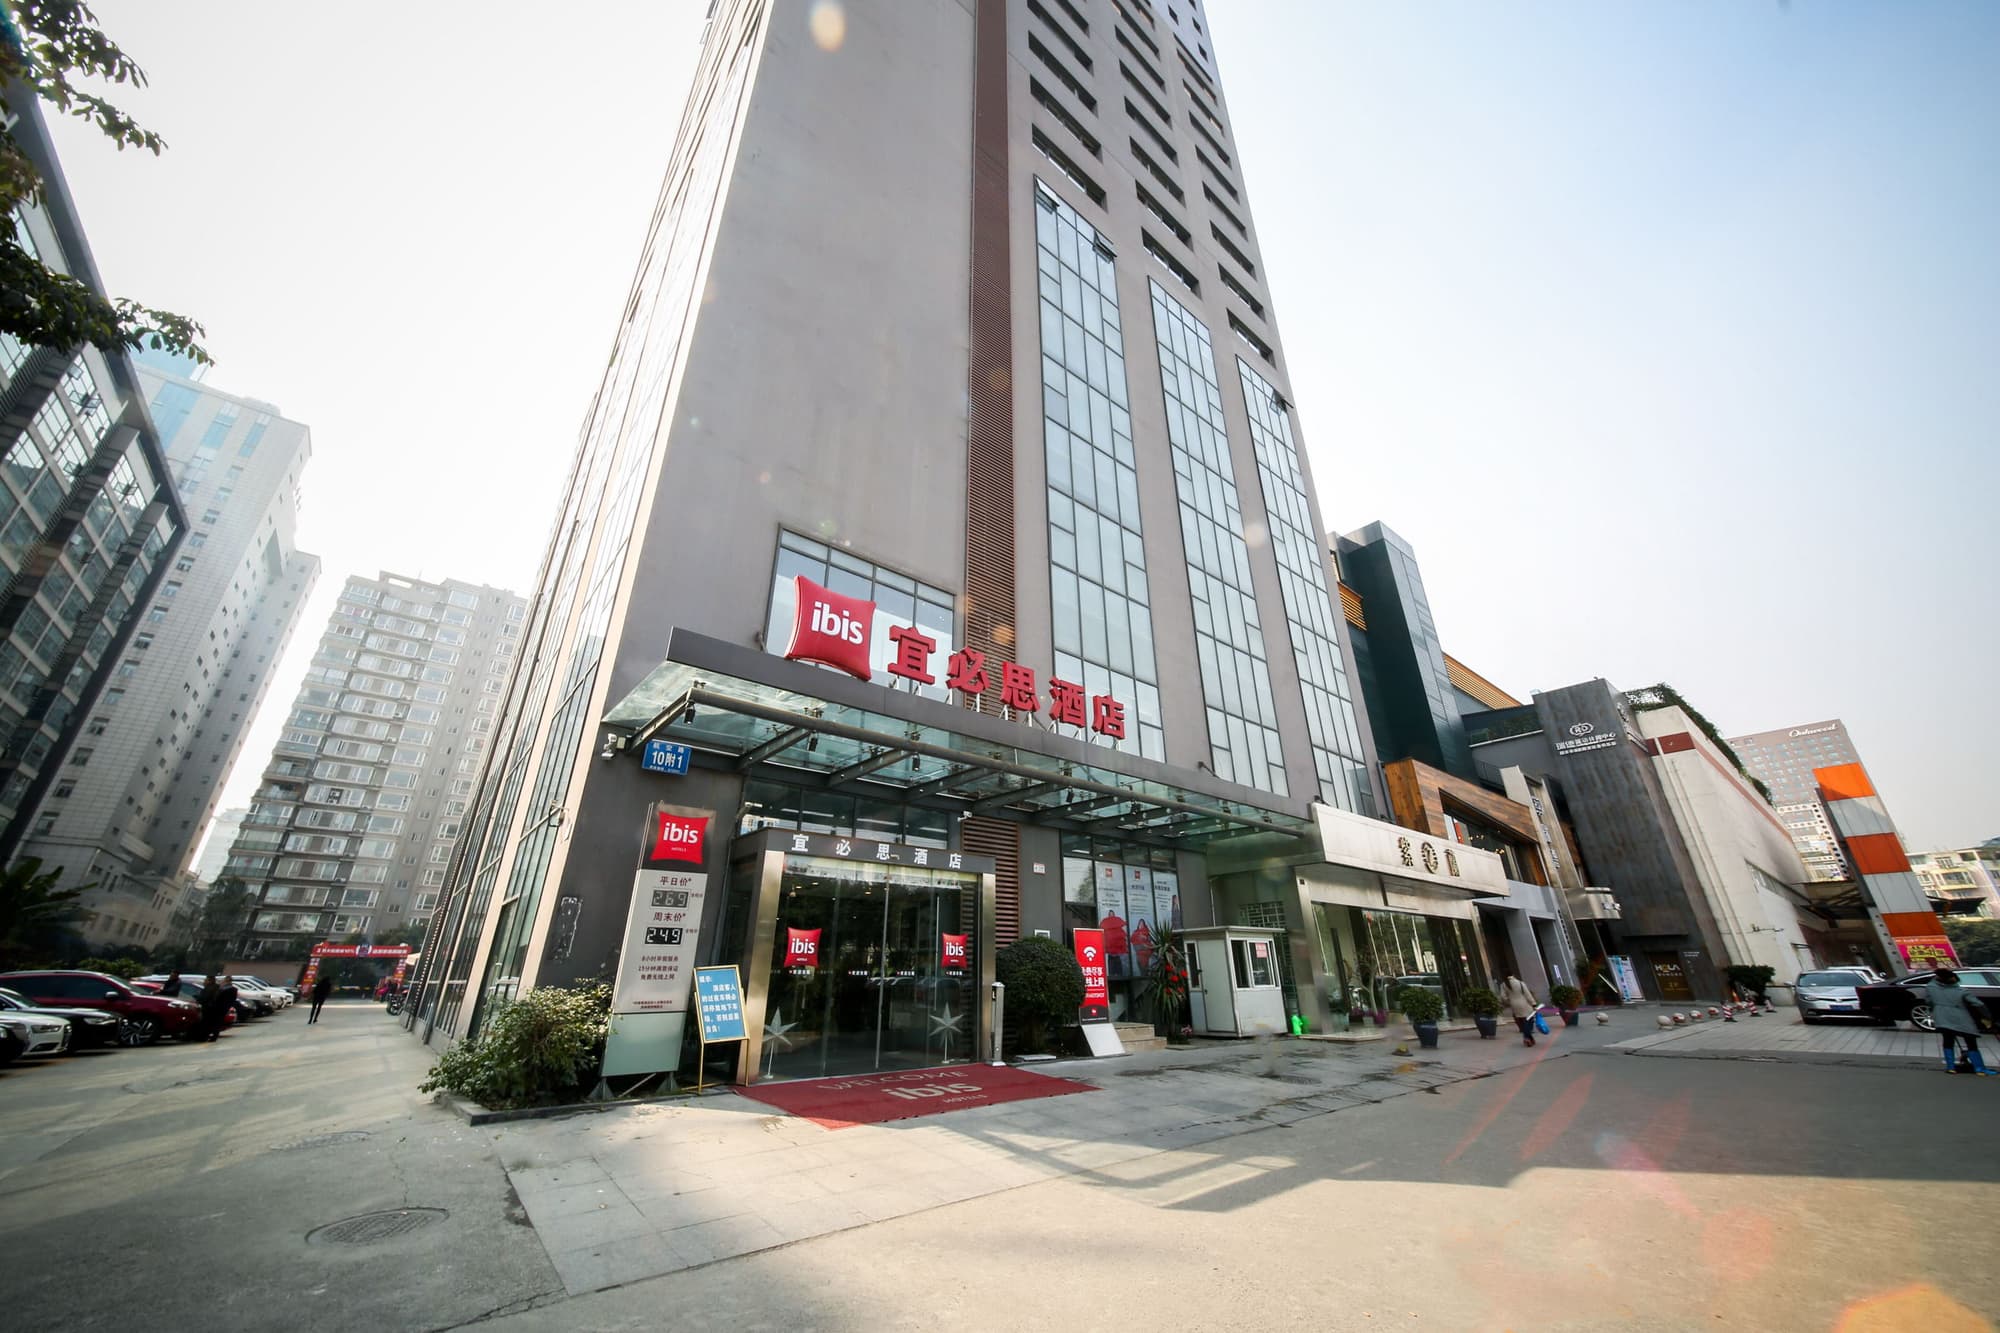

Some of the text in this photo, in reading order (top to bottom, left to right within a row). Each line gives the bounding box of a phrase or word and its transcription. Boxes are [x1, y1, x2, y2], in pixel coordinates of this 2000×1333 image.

[811, 600, 864, 645] ibis
[887, 624, 1126, 740] 宜必思酒店
[652, 750, 683, 768] 10附1
[663, 822, 698, 843] ibis
[791, 834, 962, 869] 宜必思酒店
[646, 928, 681, 943] 249
[791, 938, 816, 954] ibis
[945, 942, 965, 956] ibis
[816, 1071, 969, 1091] WELCOME
[881, 1082, 983, 1100] ibis
